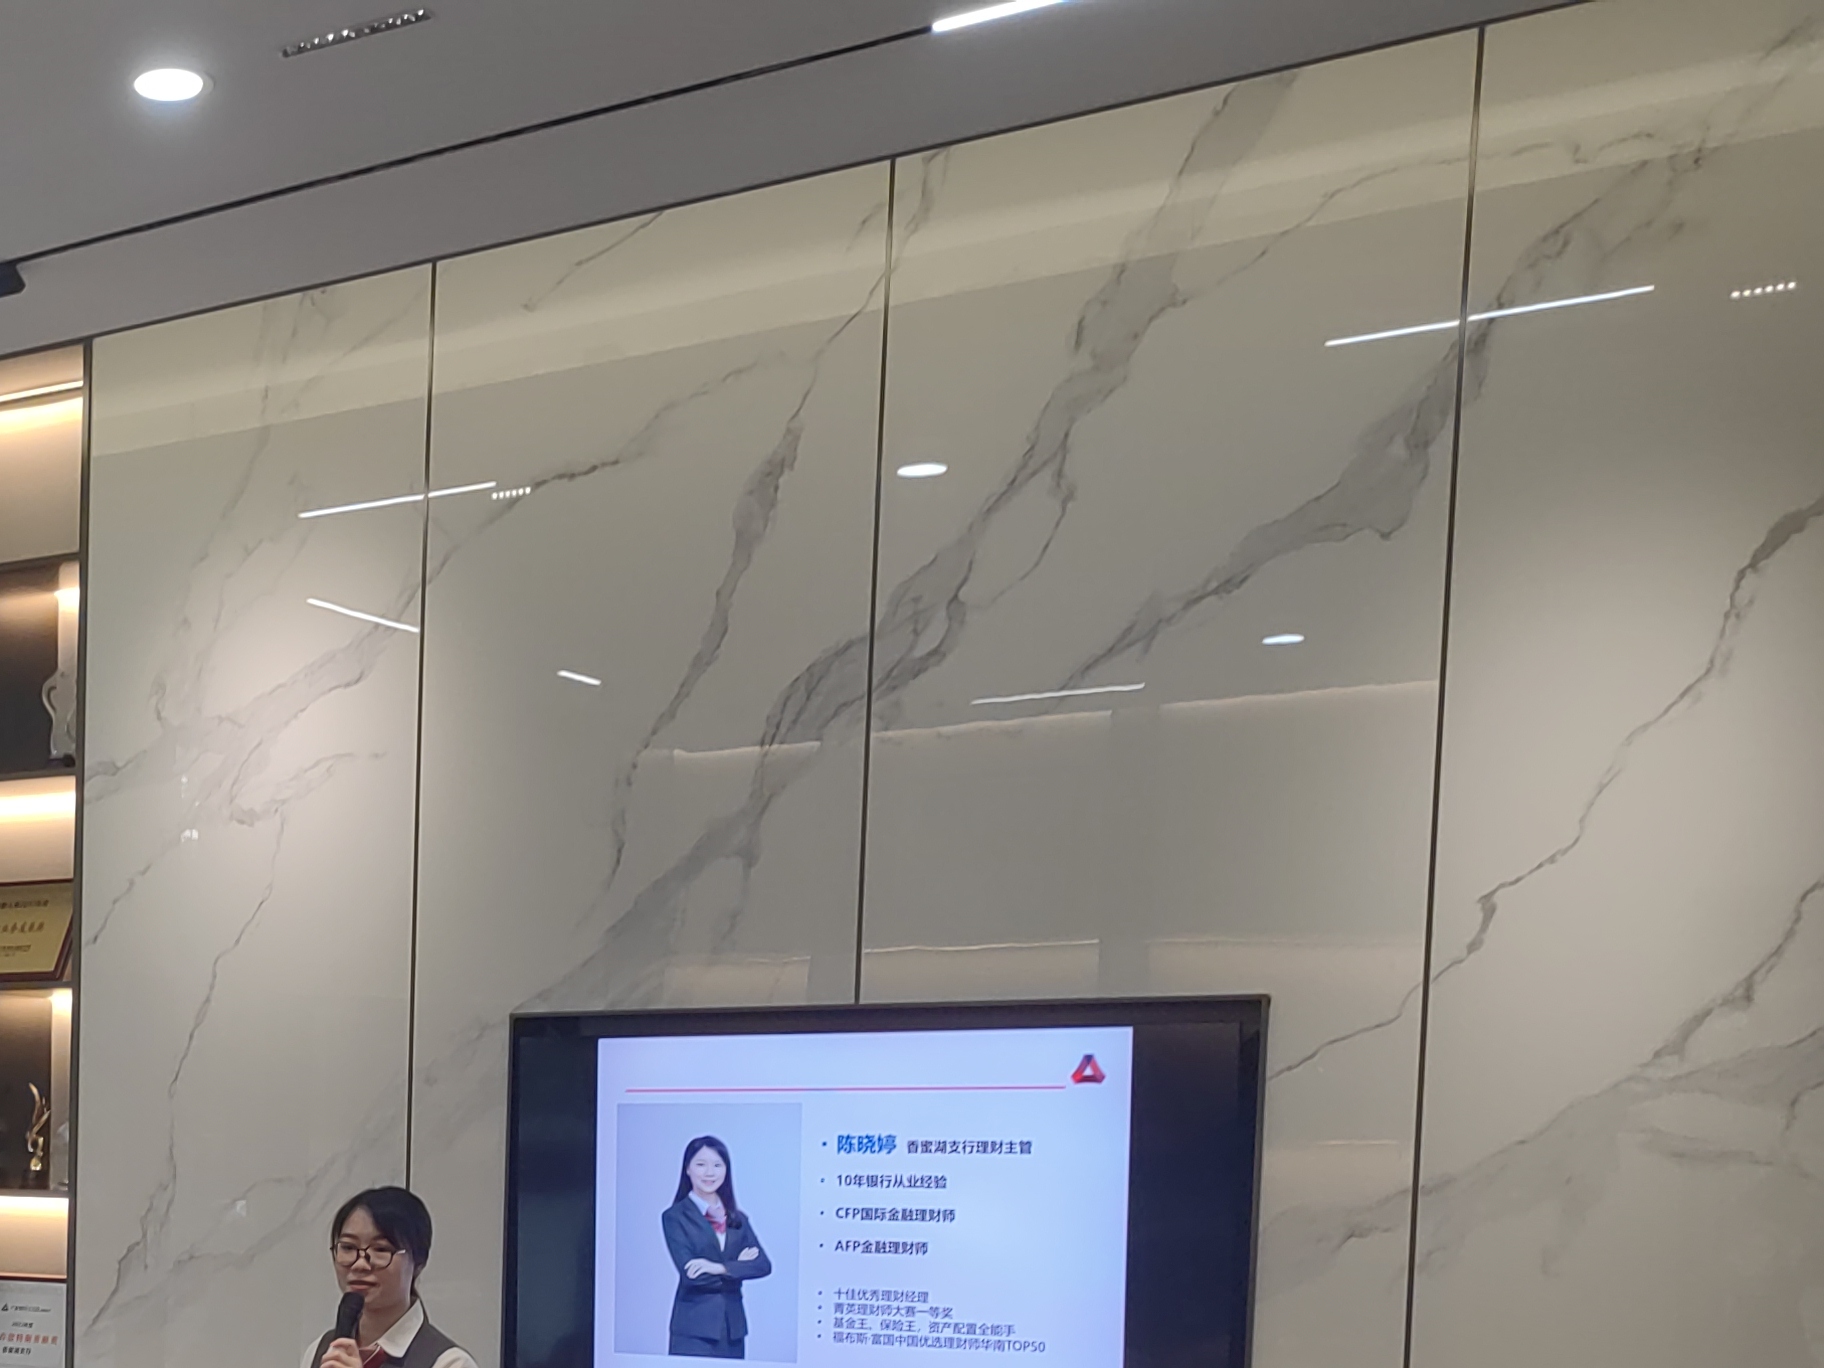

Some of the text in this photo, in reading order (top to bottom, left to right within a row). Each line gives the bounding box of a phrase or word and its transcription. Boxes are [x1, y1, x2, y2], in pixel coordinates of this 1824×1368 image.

[837, 1133, 1033, 1155] 陈晓婷 香蜜湖支行理财主管
[836, 1174, 948, 1189] 10年银行从业经验
[835, 1207, 956, 1223] CFP国际金融理财师
[834, 1239, 929, 1256] AFP金融理财师
[833, 1287, 930, 1304] 十佳优秀理财经理
[833, 1302, 954, 1319] 菁英理财师大赛一等奖
